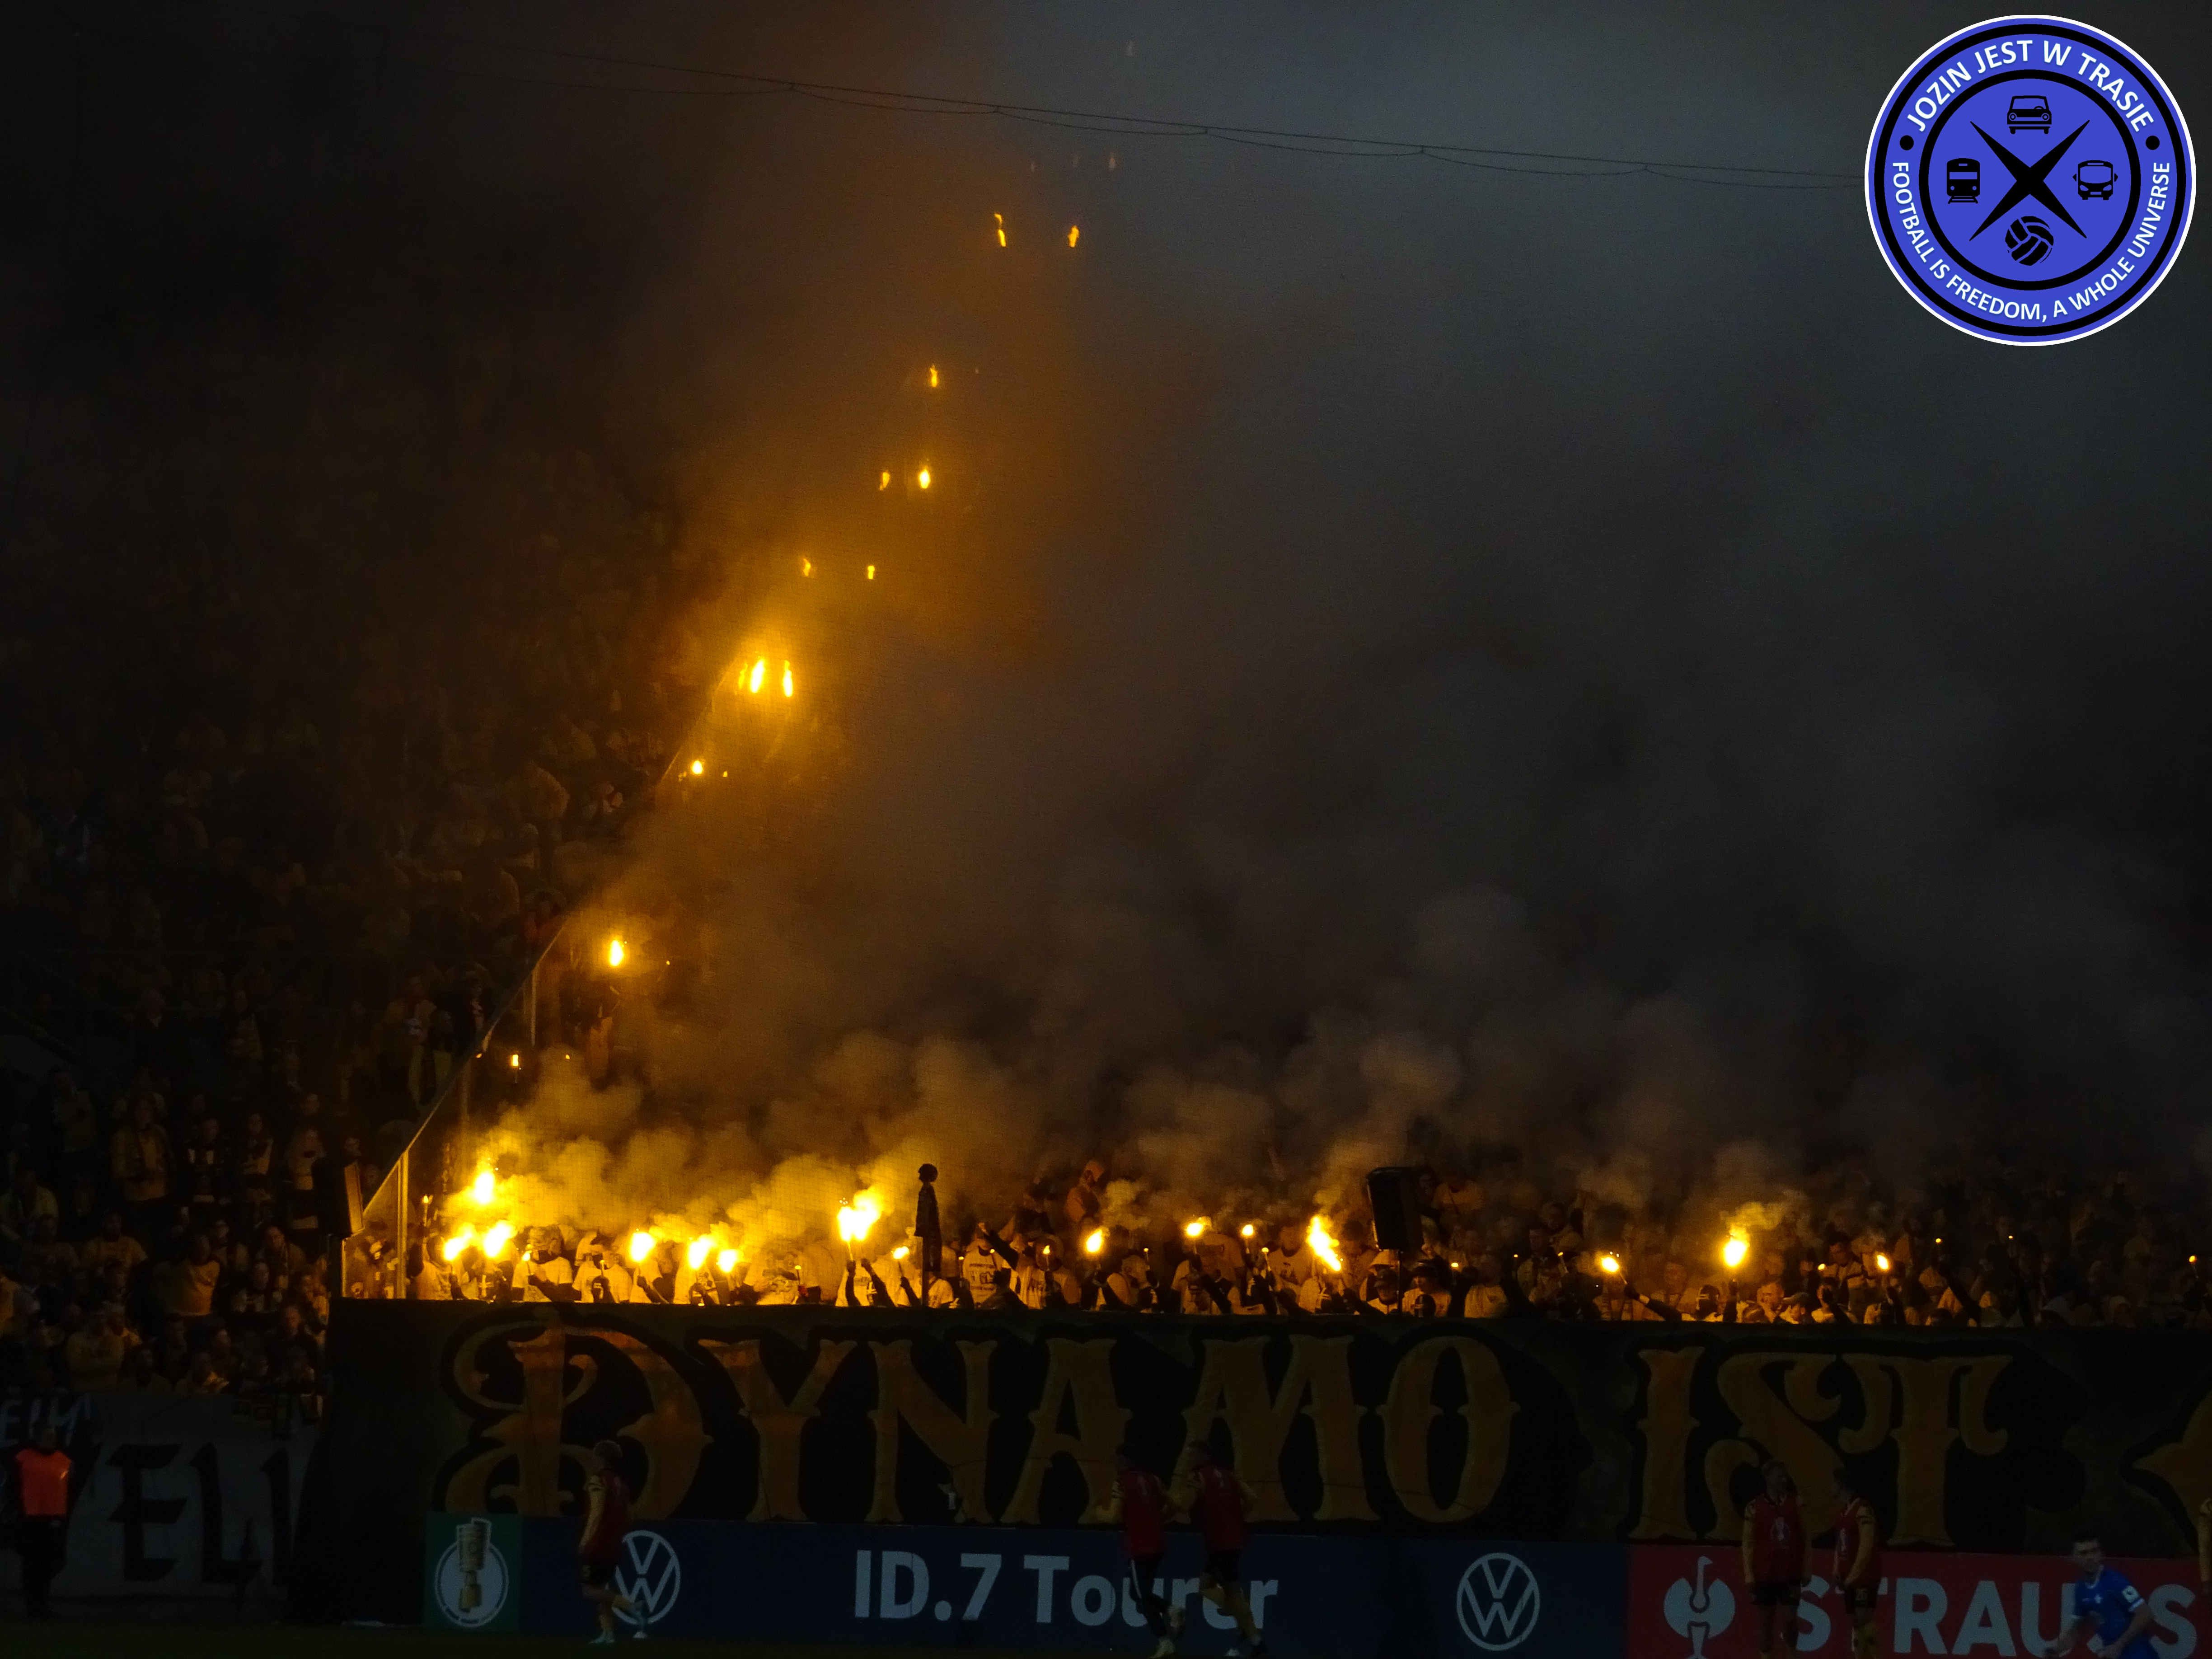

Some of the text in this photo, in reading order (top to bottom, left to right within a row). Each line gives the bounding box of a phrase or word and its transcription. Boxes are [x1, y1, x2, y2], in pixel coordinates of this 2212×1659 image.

[445, 1307, 1522, 1524] DYNAMO
[1627, 1345, 2014, 1548] IST
[854, 1549, 1002, 1621] ID.7
[1795, 1574, 2198, 1659] SRAUS
